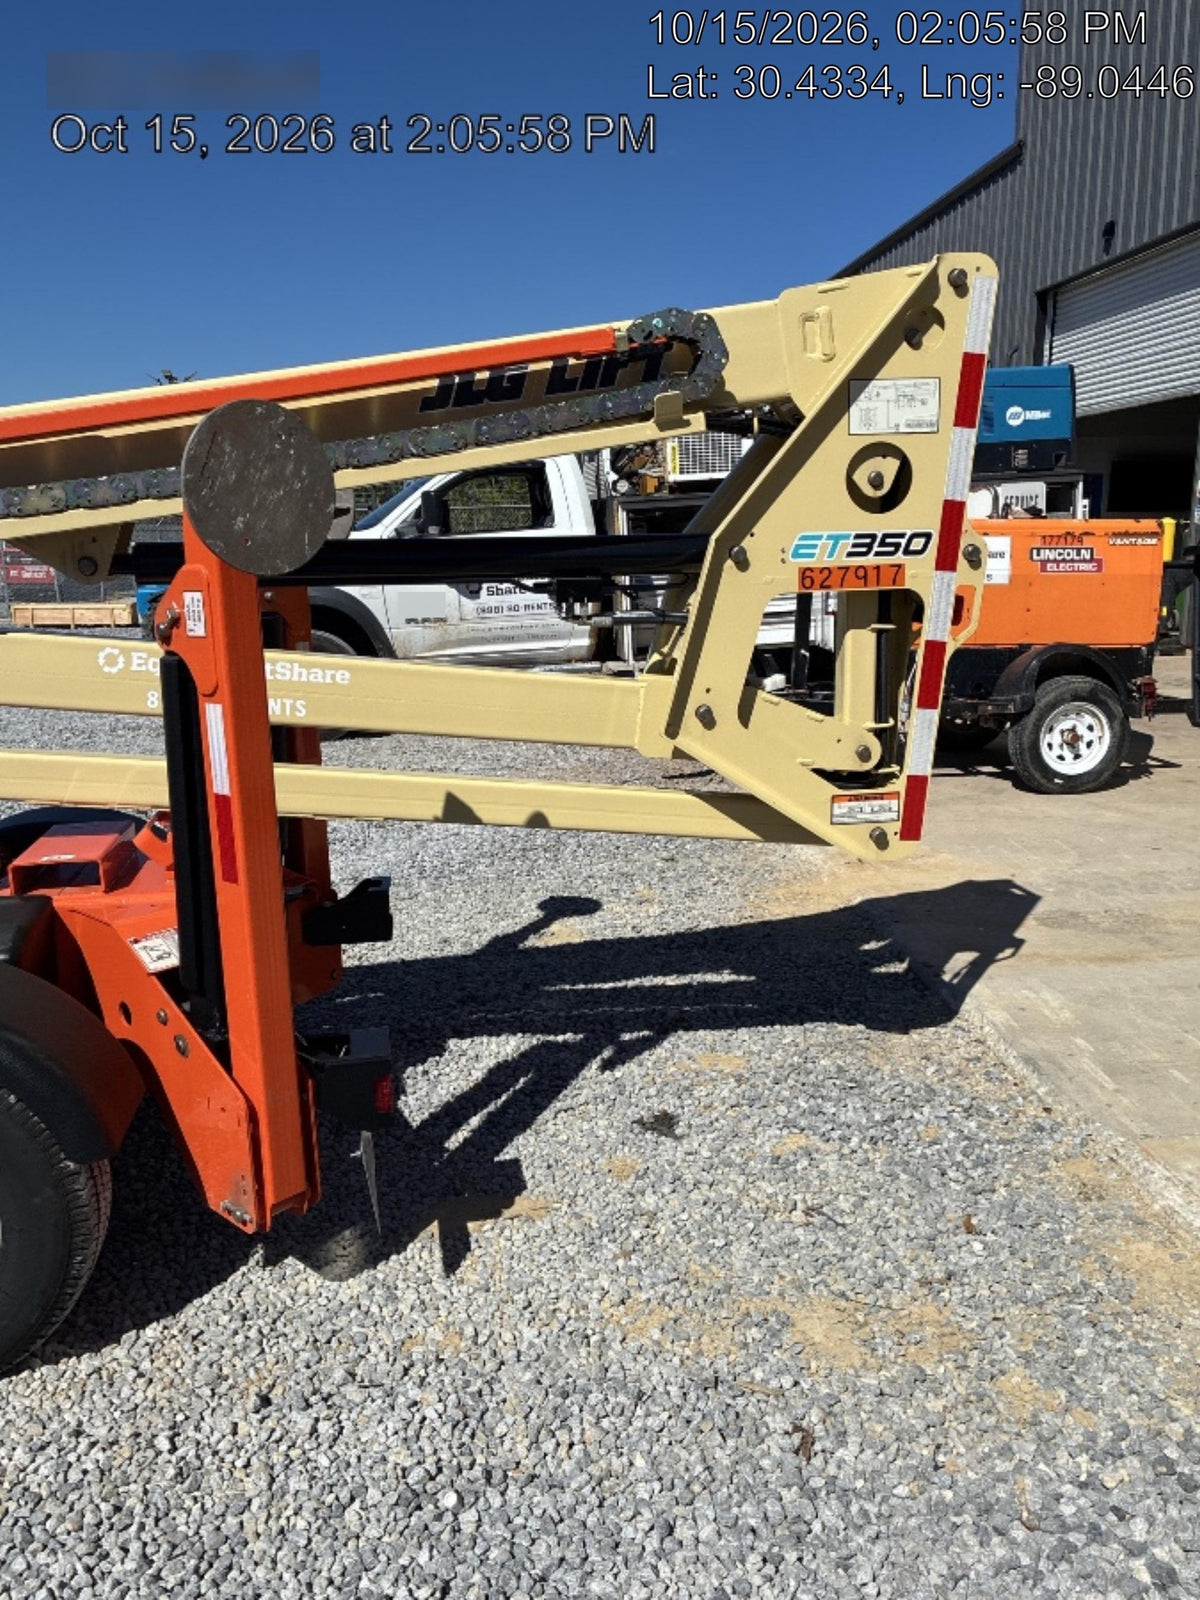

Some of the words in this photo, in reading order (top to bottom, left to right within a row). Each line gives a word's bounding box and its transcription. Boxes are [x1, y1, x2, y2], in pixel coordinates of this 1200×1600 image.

[790, 530, 934, 561] ET350
[1032, 548, 1092, 561] LINCOLN
[1046, 562, 1099, 572] ELECTRIC
[801, 564, 903, 590] 627917
